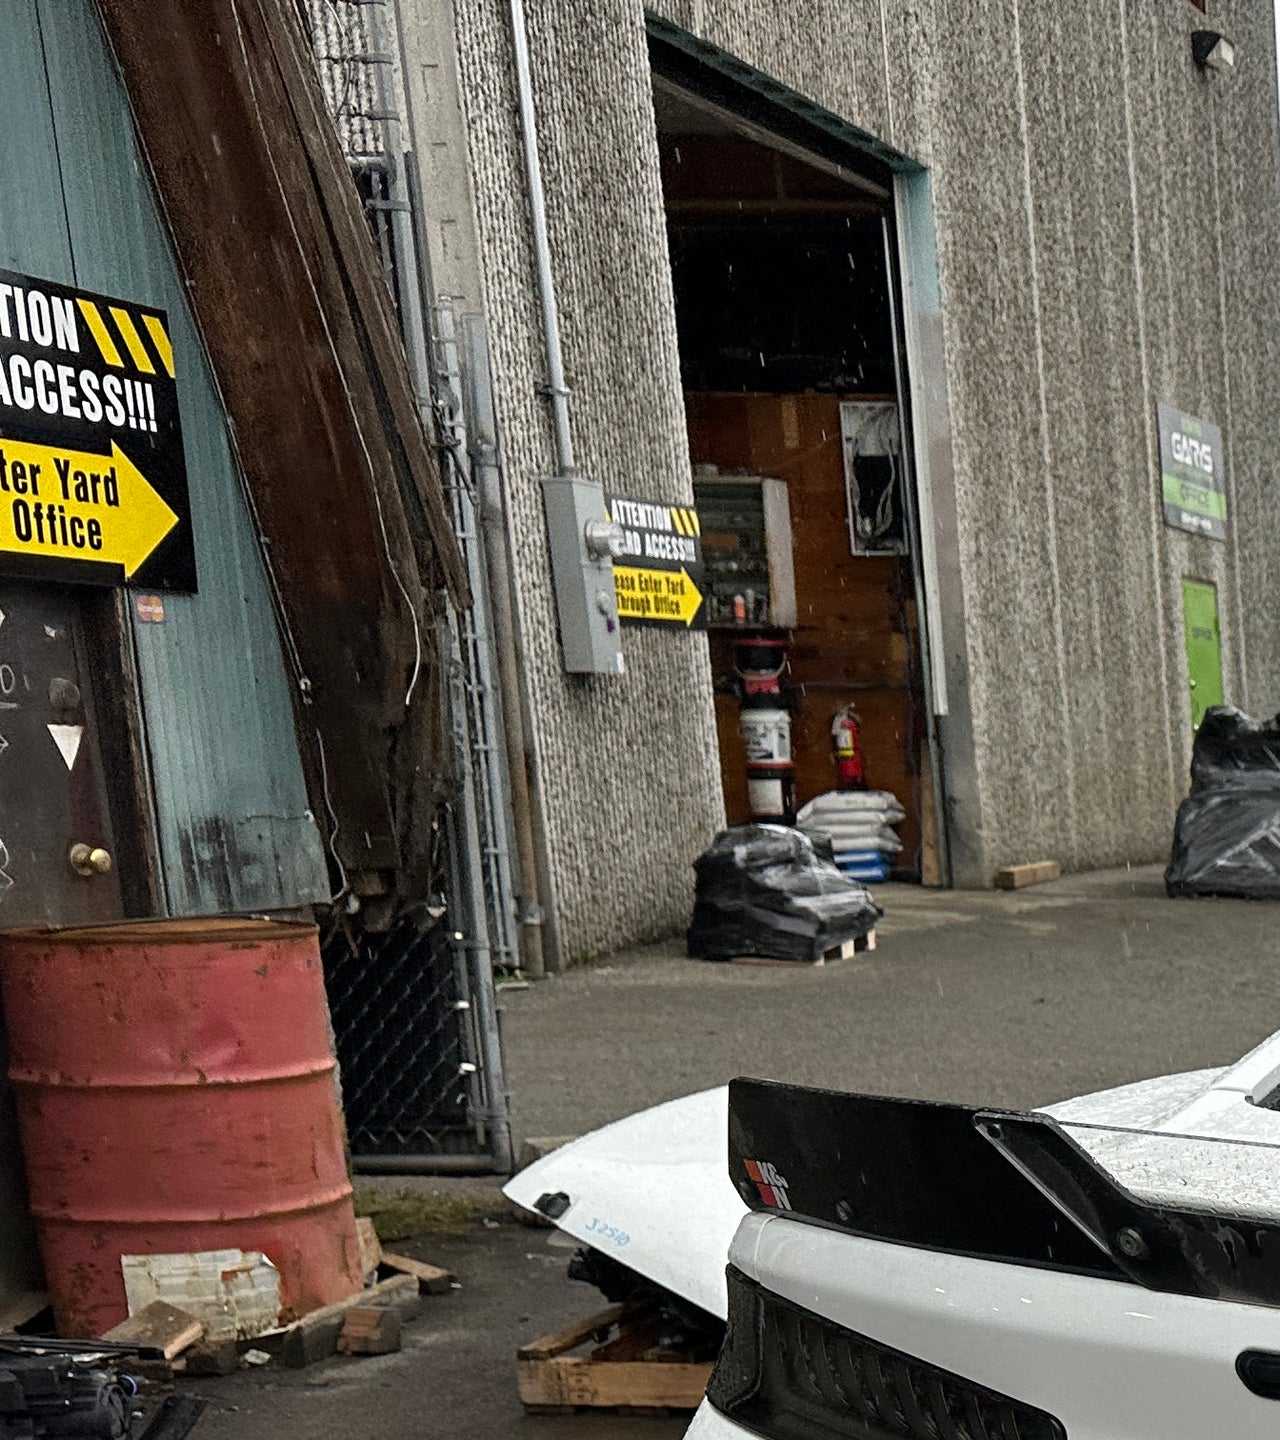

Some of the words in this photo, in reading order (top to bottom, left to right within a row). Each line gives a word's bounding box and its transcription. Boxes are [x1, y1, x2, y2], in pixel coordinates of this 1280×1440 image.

[53, 457, 119, 507] Yard
[12, 498, 103, 550] Office
[611, 499, 672, 532] ATTENTION
[638, 573, 662, 593] Enter
[666, 576, 685, 596] Yard
[654, 595, 681, 615] Office
